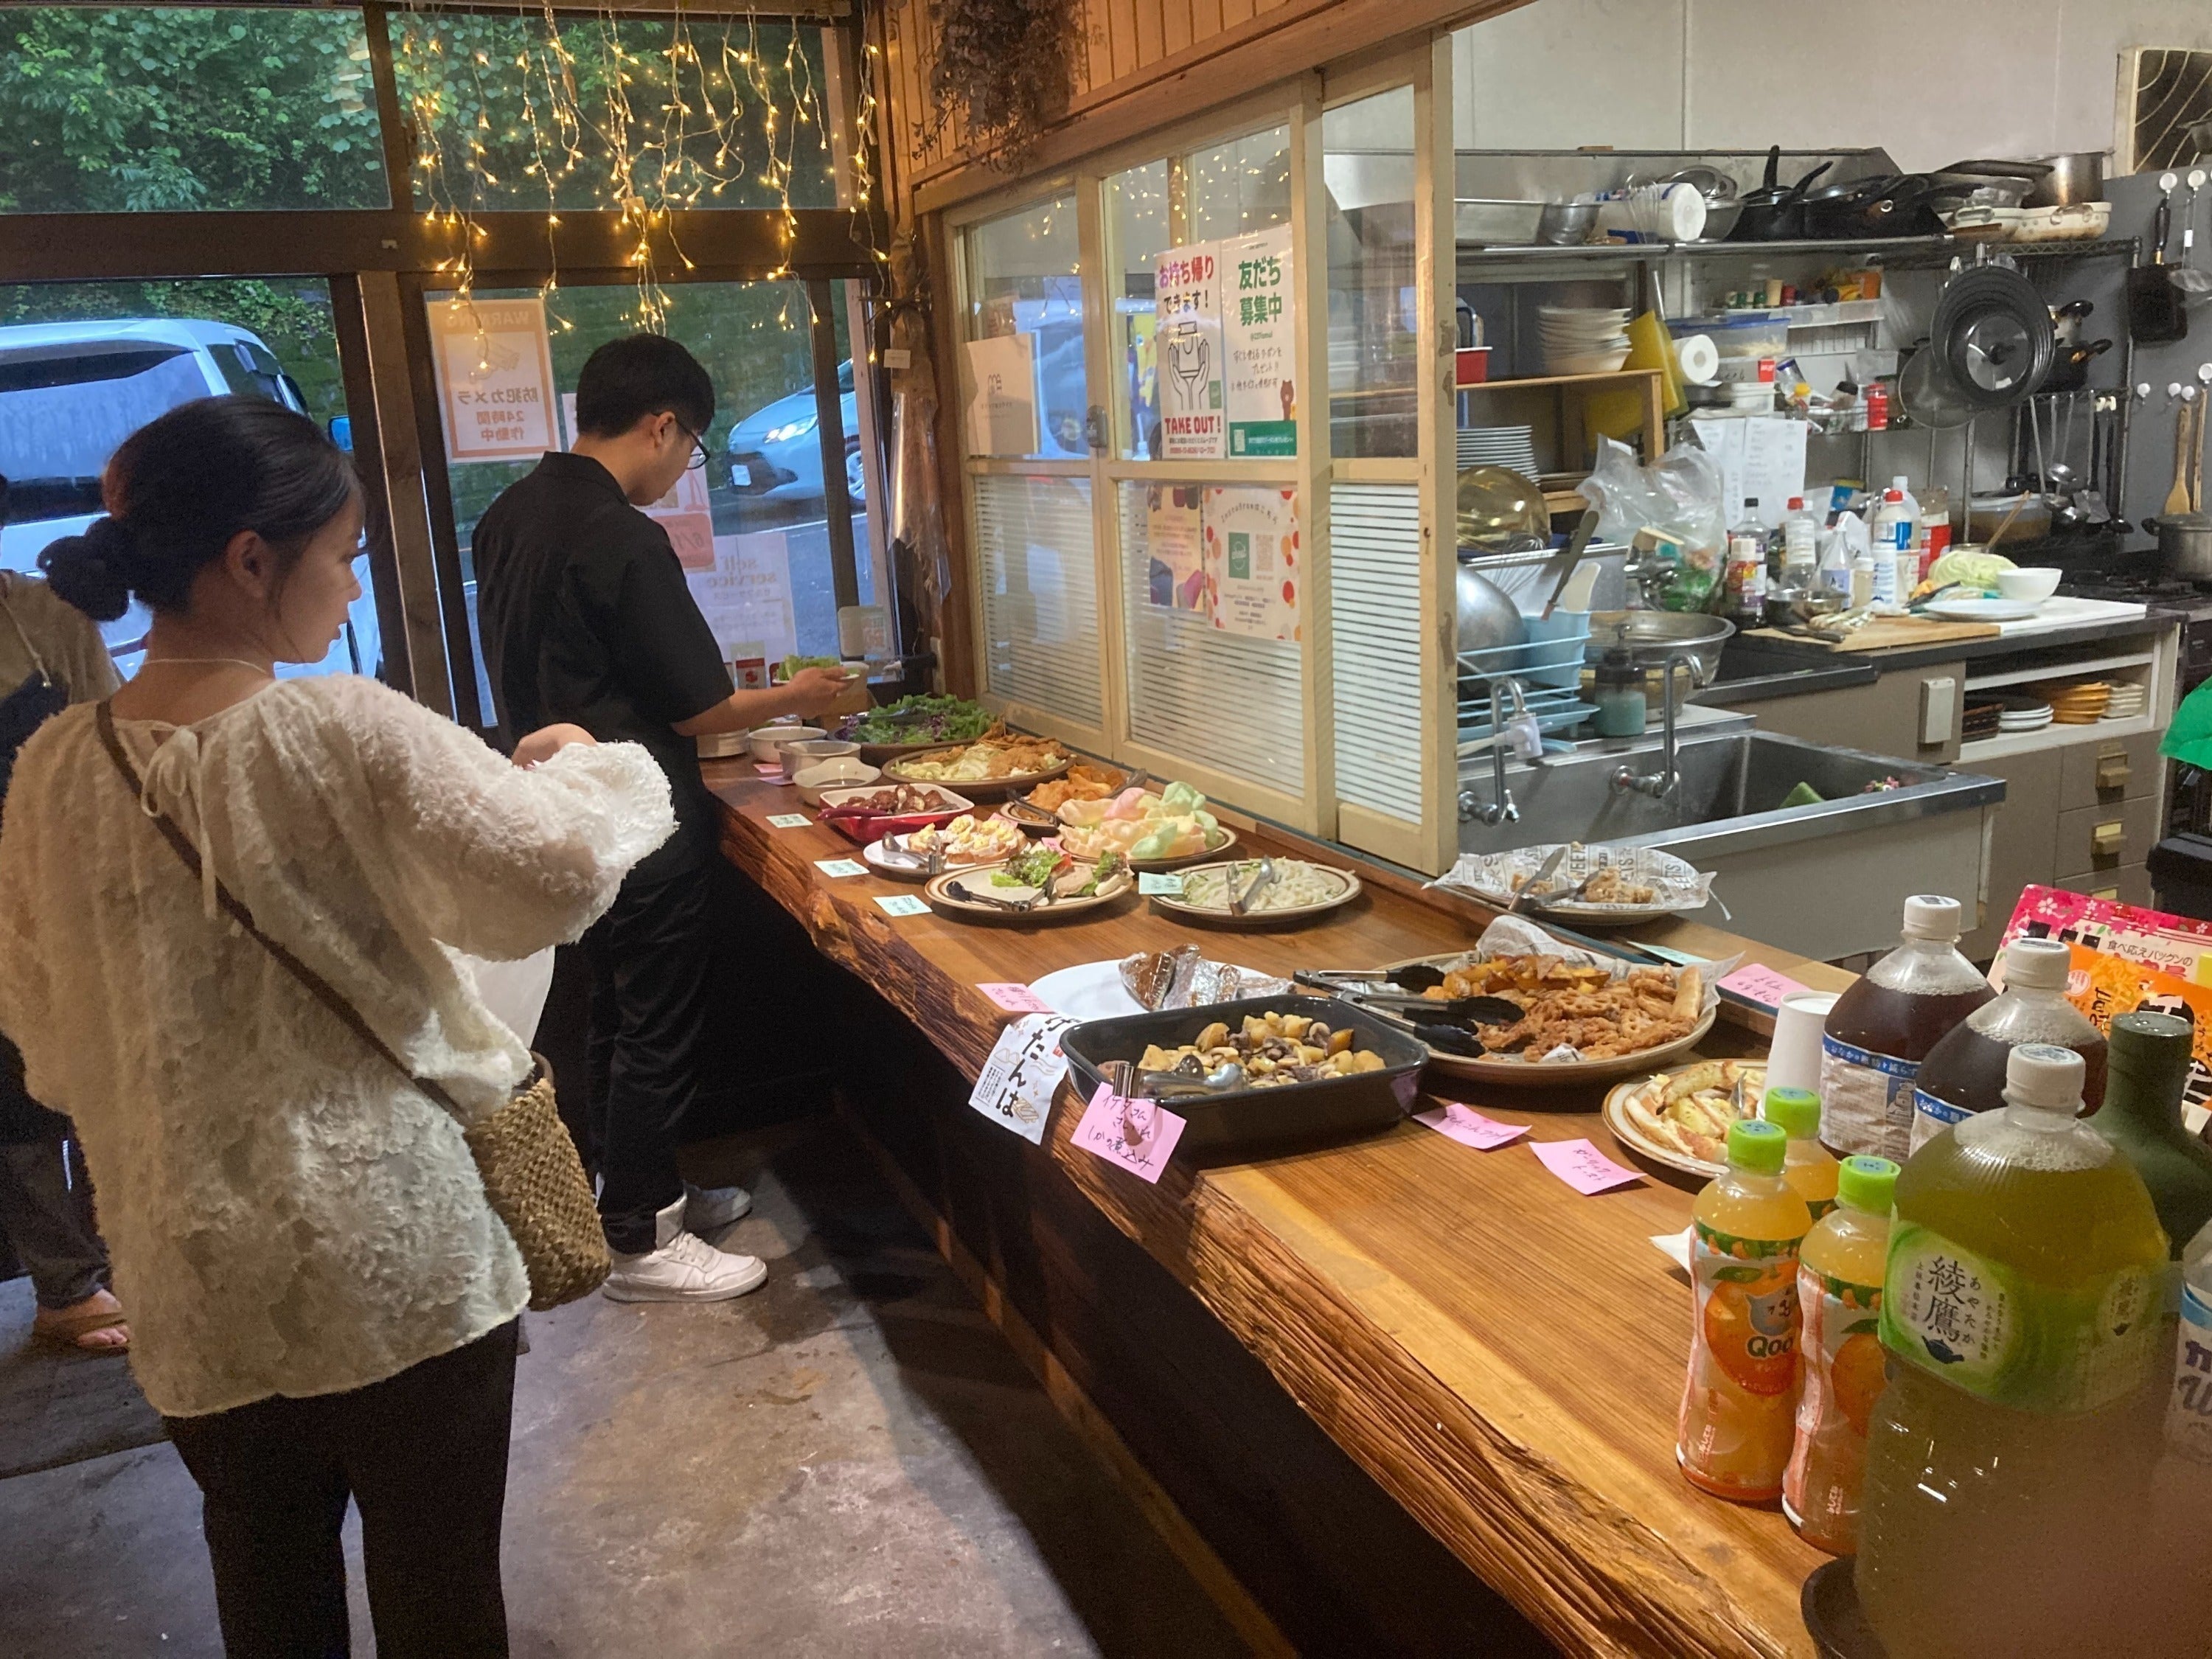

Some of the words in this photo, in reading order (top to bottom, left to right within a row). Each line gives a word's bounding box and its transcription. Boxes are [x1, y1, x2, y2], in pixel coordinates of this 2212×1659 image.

[1159, 255, 1214, 289] お持ち帰り
[1238, 256, 1281, 291] 友だち
[1239, 292, 1282, 327] 募集中
[1164, 417, 1192, 434] TAKE
[2107, 939, 2194, 967] 食べ応えバツグンの
[1923, 1256, 1966, 1343] 綾鷹
[1961, 1276, 1982, 1344] あやたか
[1746, 1335, 1794, 1357] Qoo
